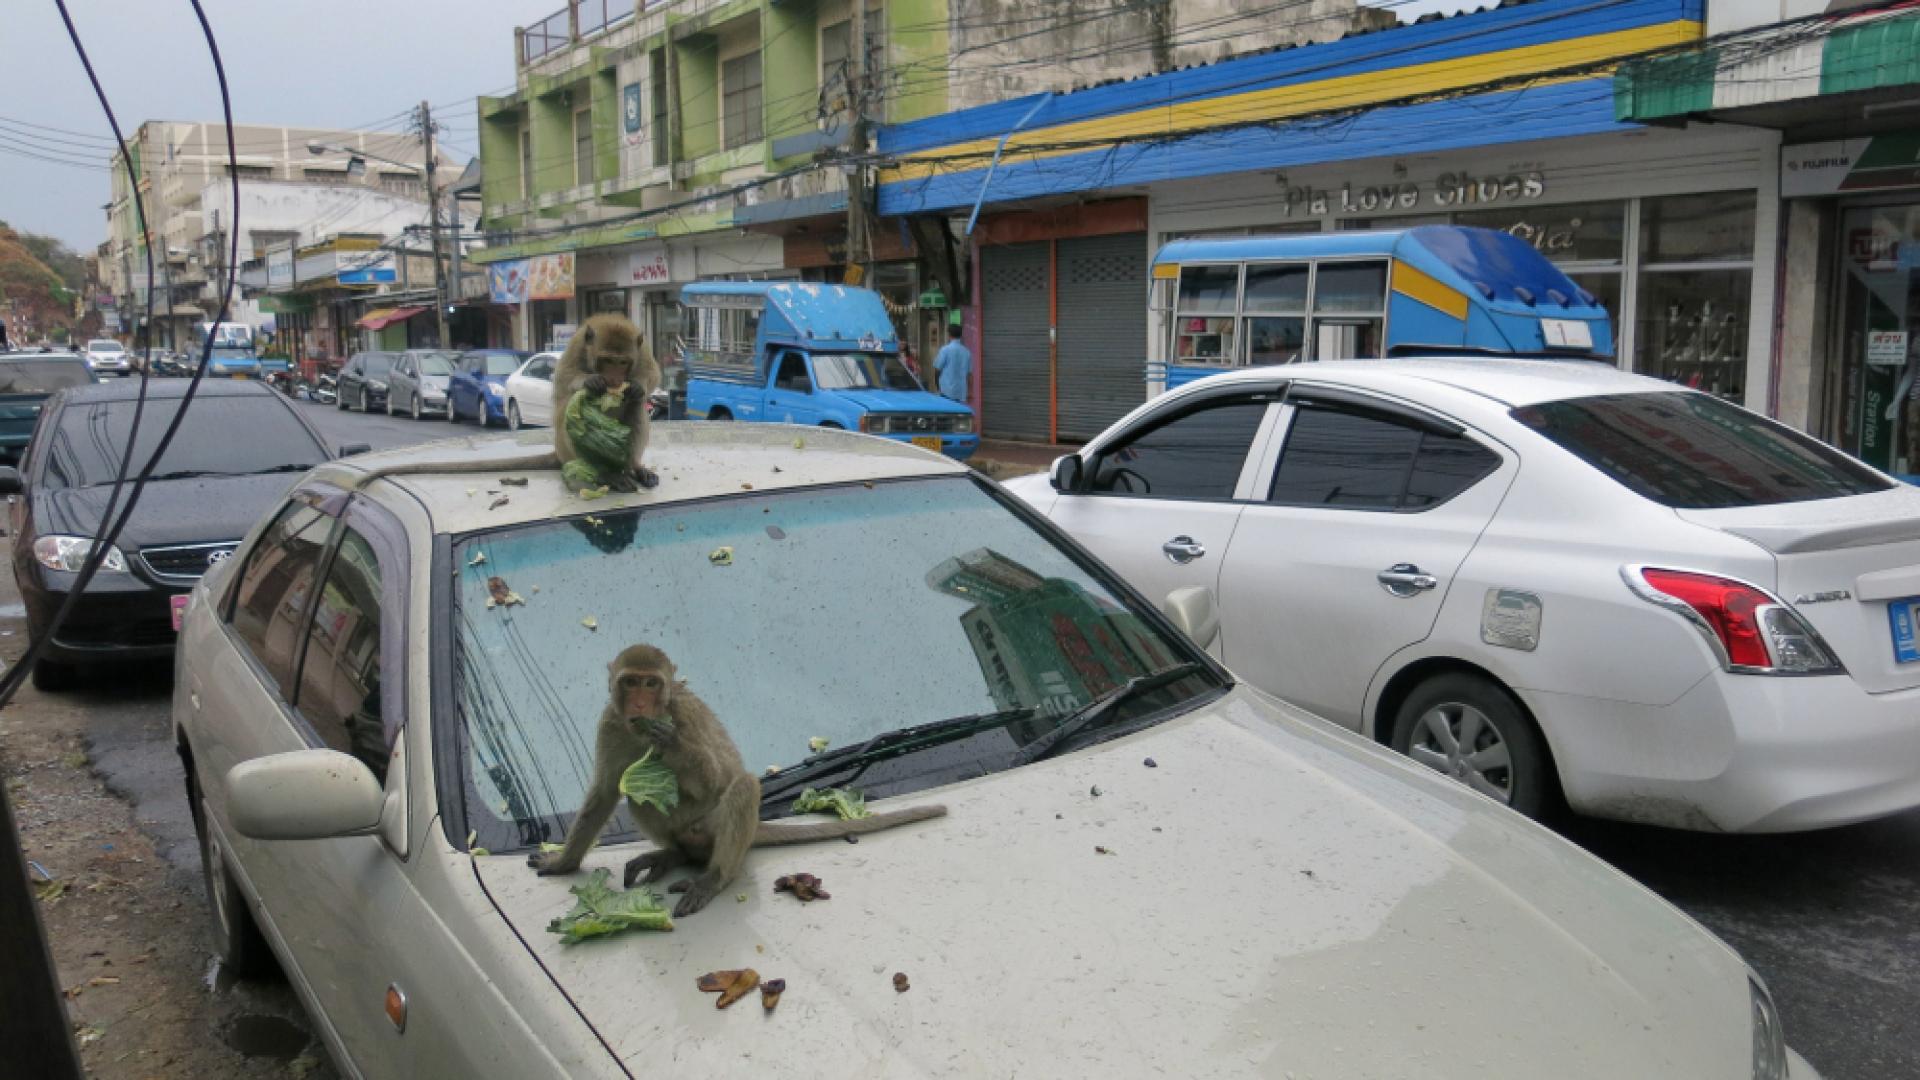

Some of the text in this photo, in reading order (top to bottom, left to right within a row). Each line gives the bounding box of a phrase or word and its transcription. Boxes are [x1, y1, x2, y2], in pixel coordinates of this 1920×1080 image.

[1802, 157, 1850, 170] FUJIFILM
[1341, 181, 1419, 213] Love
[1433, 170, 1544, 205] Shoes
[1863, 389, 1881, 448] Station
